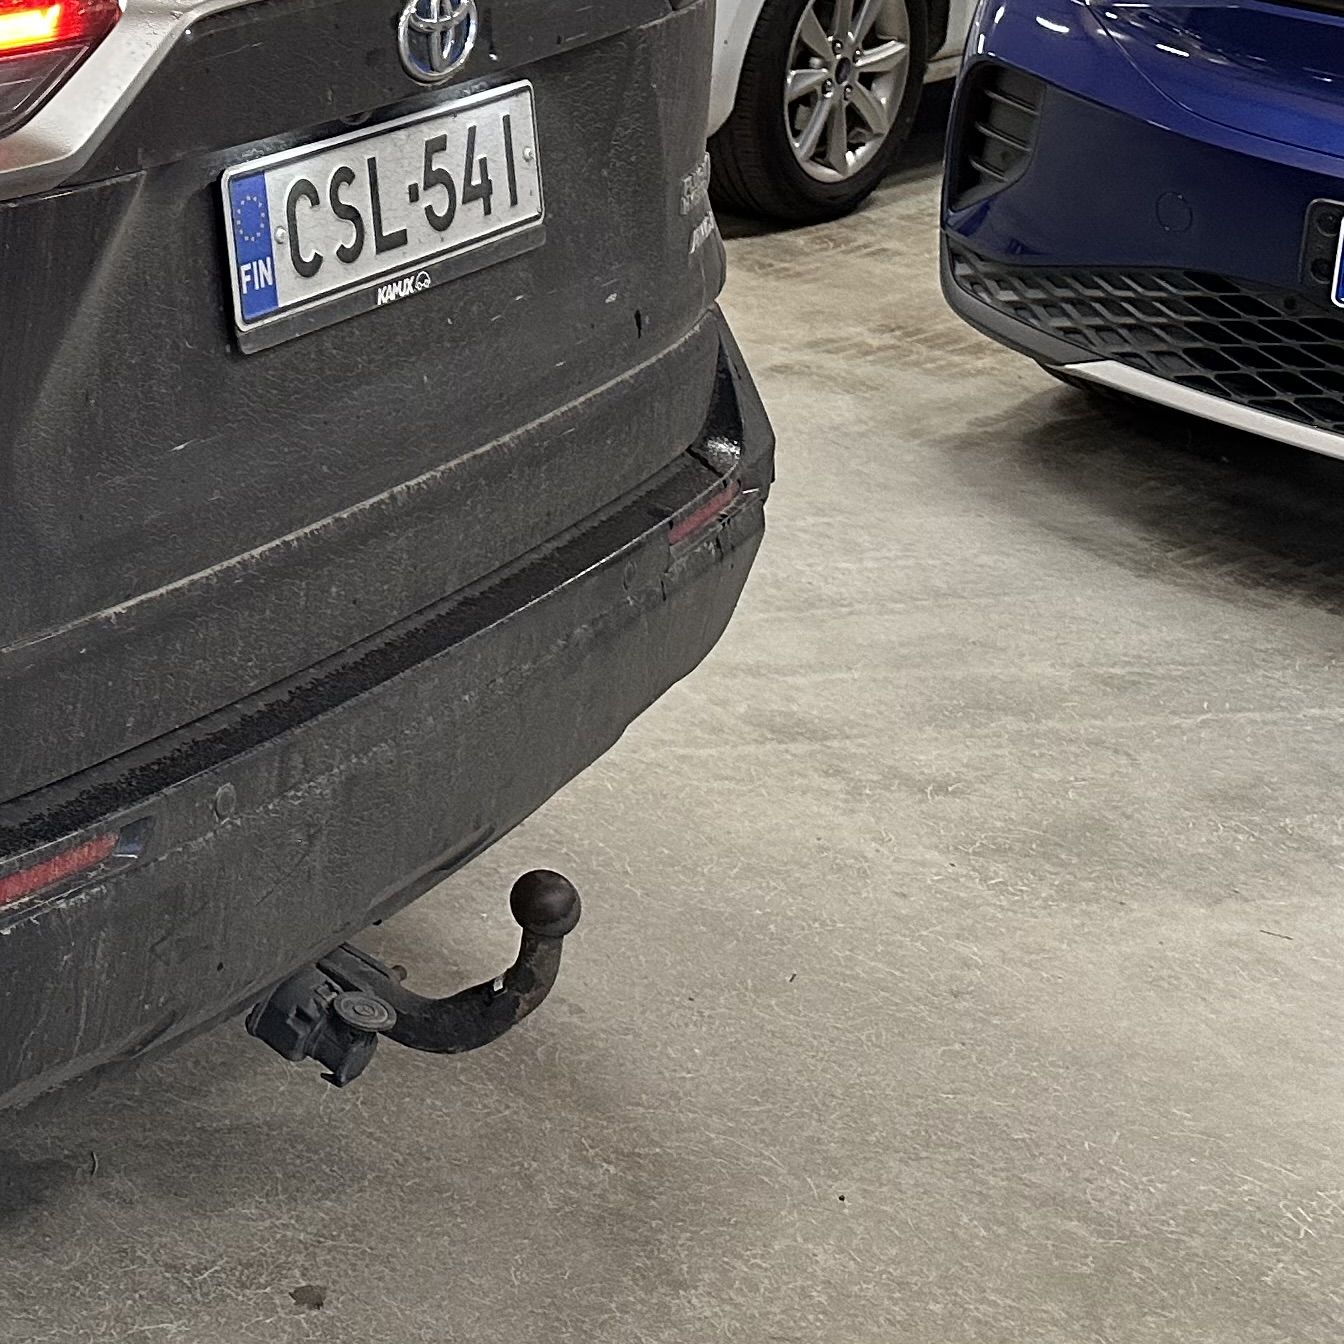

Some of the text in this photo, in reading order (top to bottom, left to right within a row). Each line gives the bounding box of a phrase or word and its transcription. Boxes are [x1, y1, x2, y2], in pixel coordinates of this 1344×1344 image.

[286, 114, 518, 278] CSL-541
[240, 257, 273, 294] FIN
[377, 275, 415, 306] KAMUX
